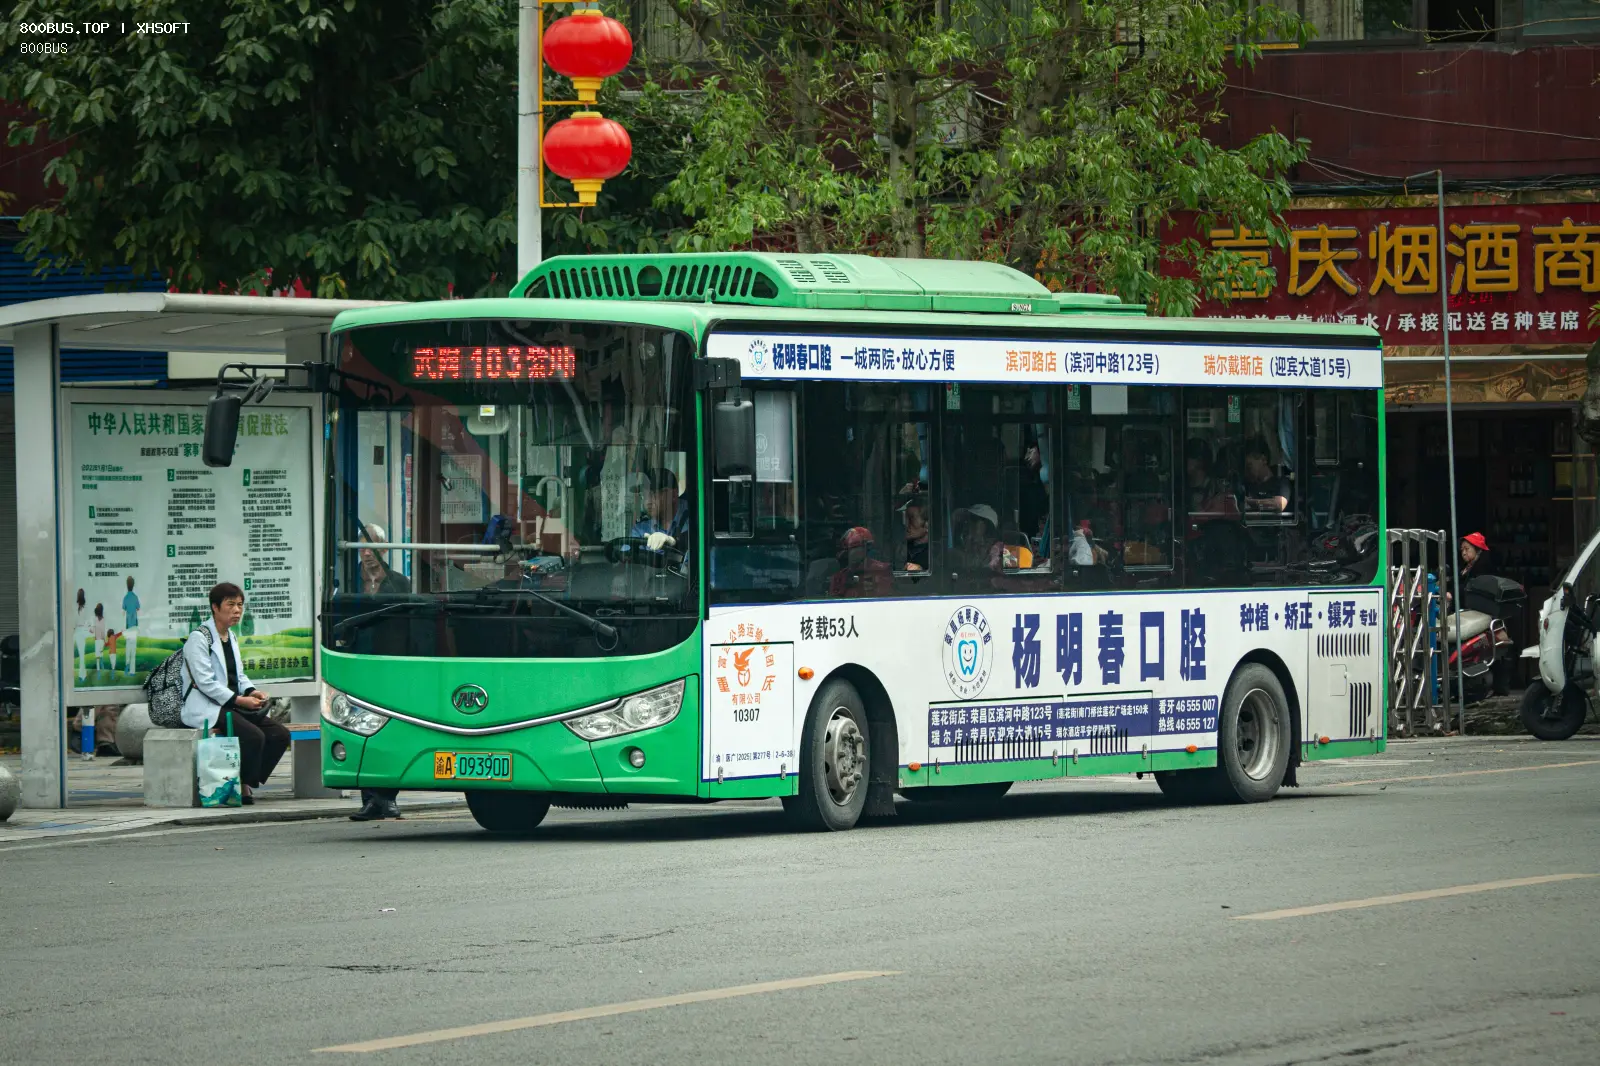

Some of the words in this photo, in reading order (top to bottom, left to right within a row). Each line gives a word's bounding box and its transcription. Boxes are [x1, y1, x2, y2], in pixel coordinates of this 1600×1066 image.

[470, 346, 522, 379] 103
[772, 343, 832, 371] 杨明春口腔
[1005, 350, 1057, 372] 滨河路店
[1203, 354, 1263, 376] 瑞尔戴斯店
[800, 615, 860, 641] 核载53人
[1012, 607, 1207, 689] 杨明春口腔
[732, 692, 761, 705] 有限公司
[1158, 698, 1175, 715] 看牙
[733, 708, 760, 722] 10307
[1158, 717, 1175, 732] 热线
